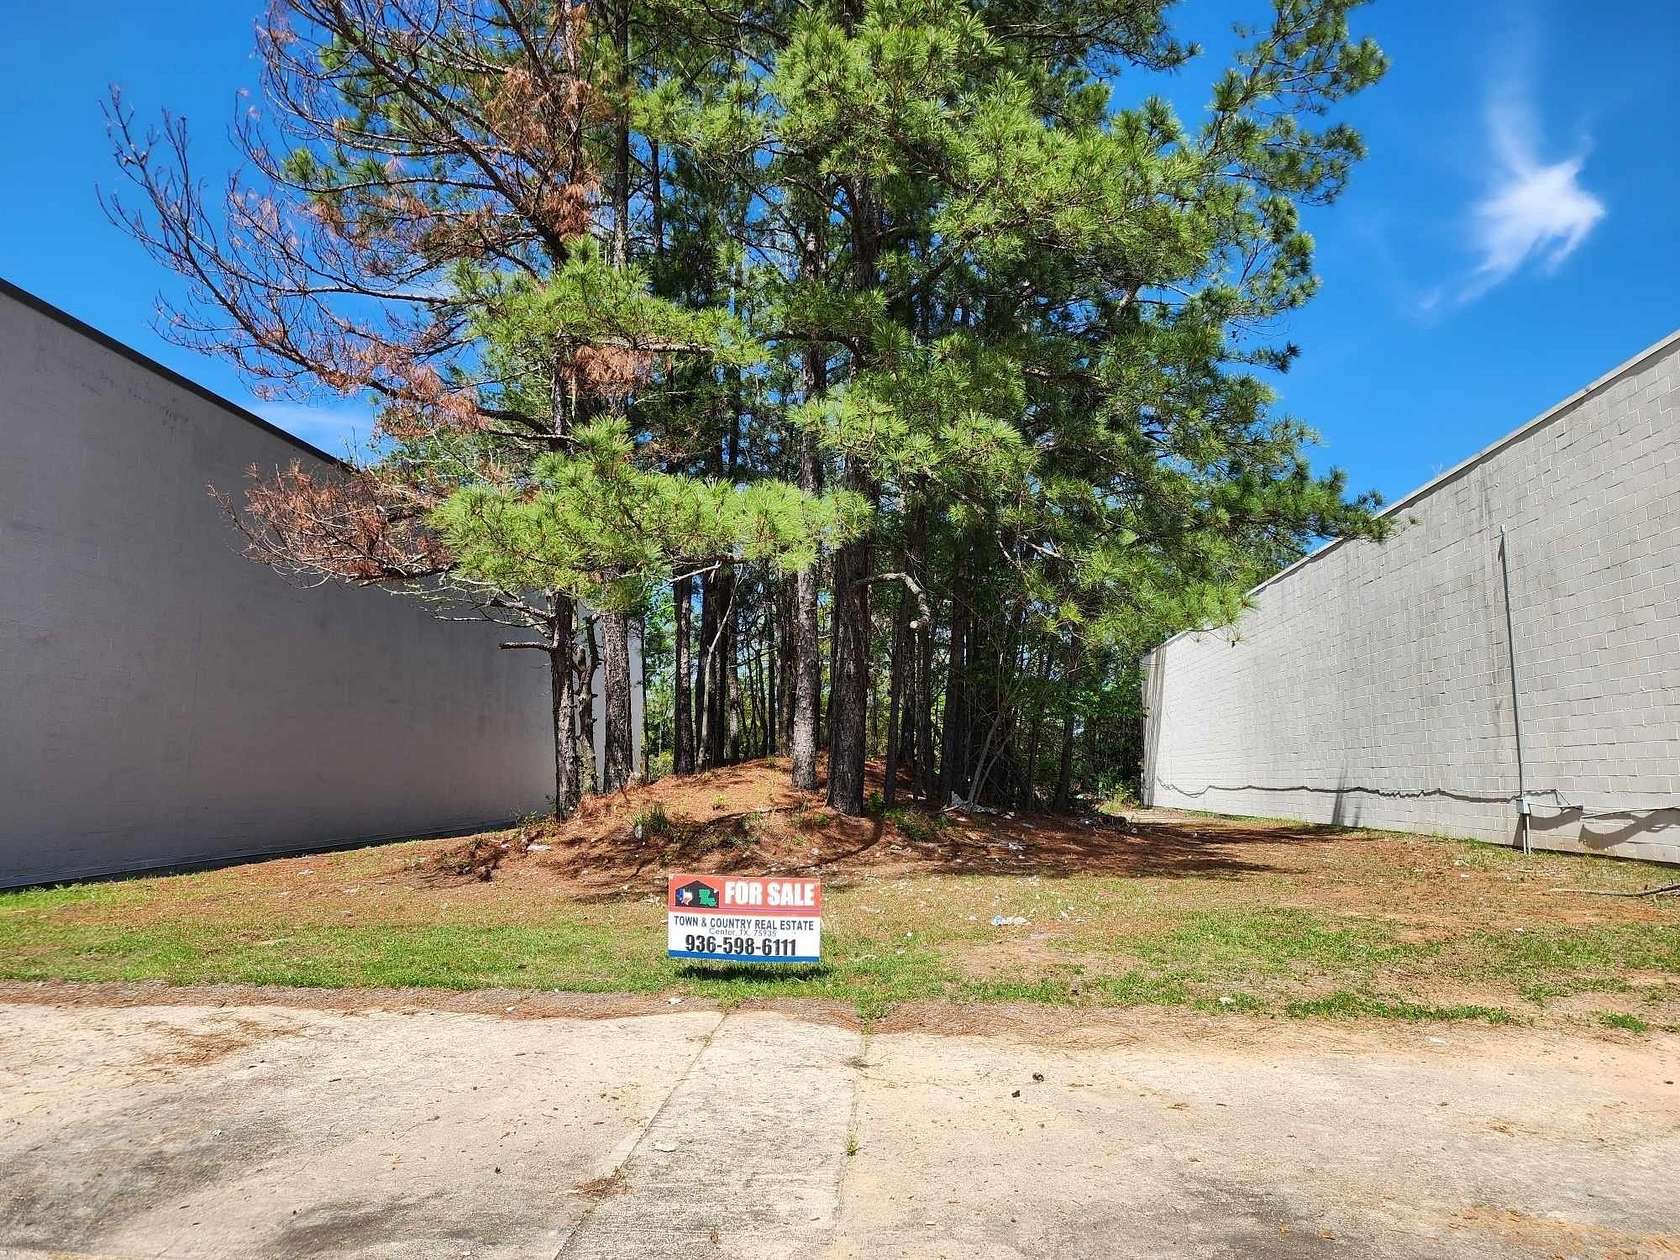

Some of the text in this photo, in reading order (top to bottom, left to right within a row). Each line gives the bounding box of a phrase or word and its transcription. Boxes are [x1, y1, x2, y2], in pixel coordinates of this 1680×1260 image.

[725, 881, 816, 906] FOR SALE
[674, 915, 814, 931] TOWN & COUNTRY REAL ESTATE
[685, 934, 797, 956] 936-598-6111
